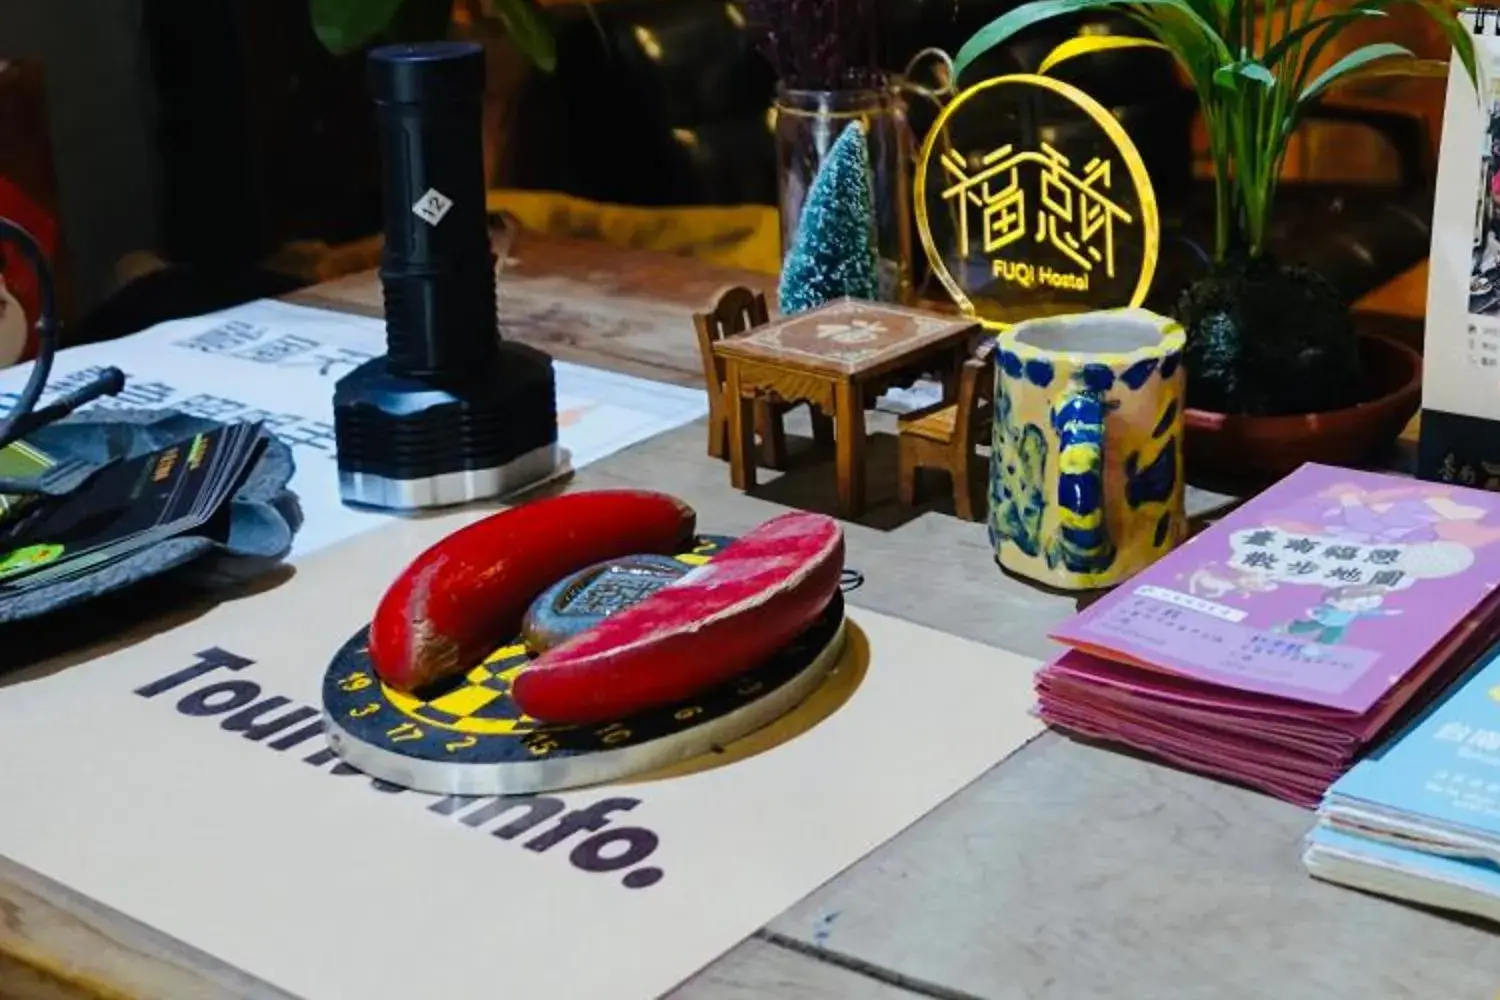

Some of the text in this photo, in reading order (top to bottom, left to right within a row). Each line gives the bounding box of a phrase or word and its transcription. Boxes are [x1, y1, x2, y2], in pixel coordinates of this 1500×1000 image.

[421, 197, 446, 216] 12
[992, 259, 1089, 291] FUQI Hostel
[133, 646, 410, 793] Tour
[349, 703, 381, 717] 3
[386, 722, 424, 743] 17
